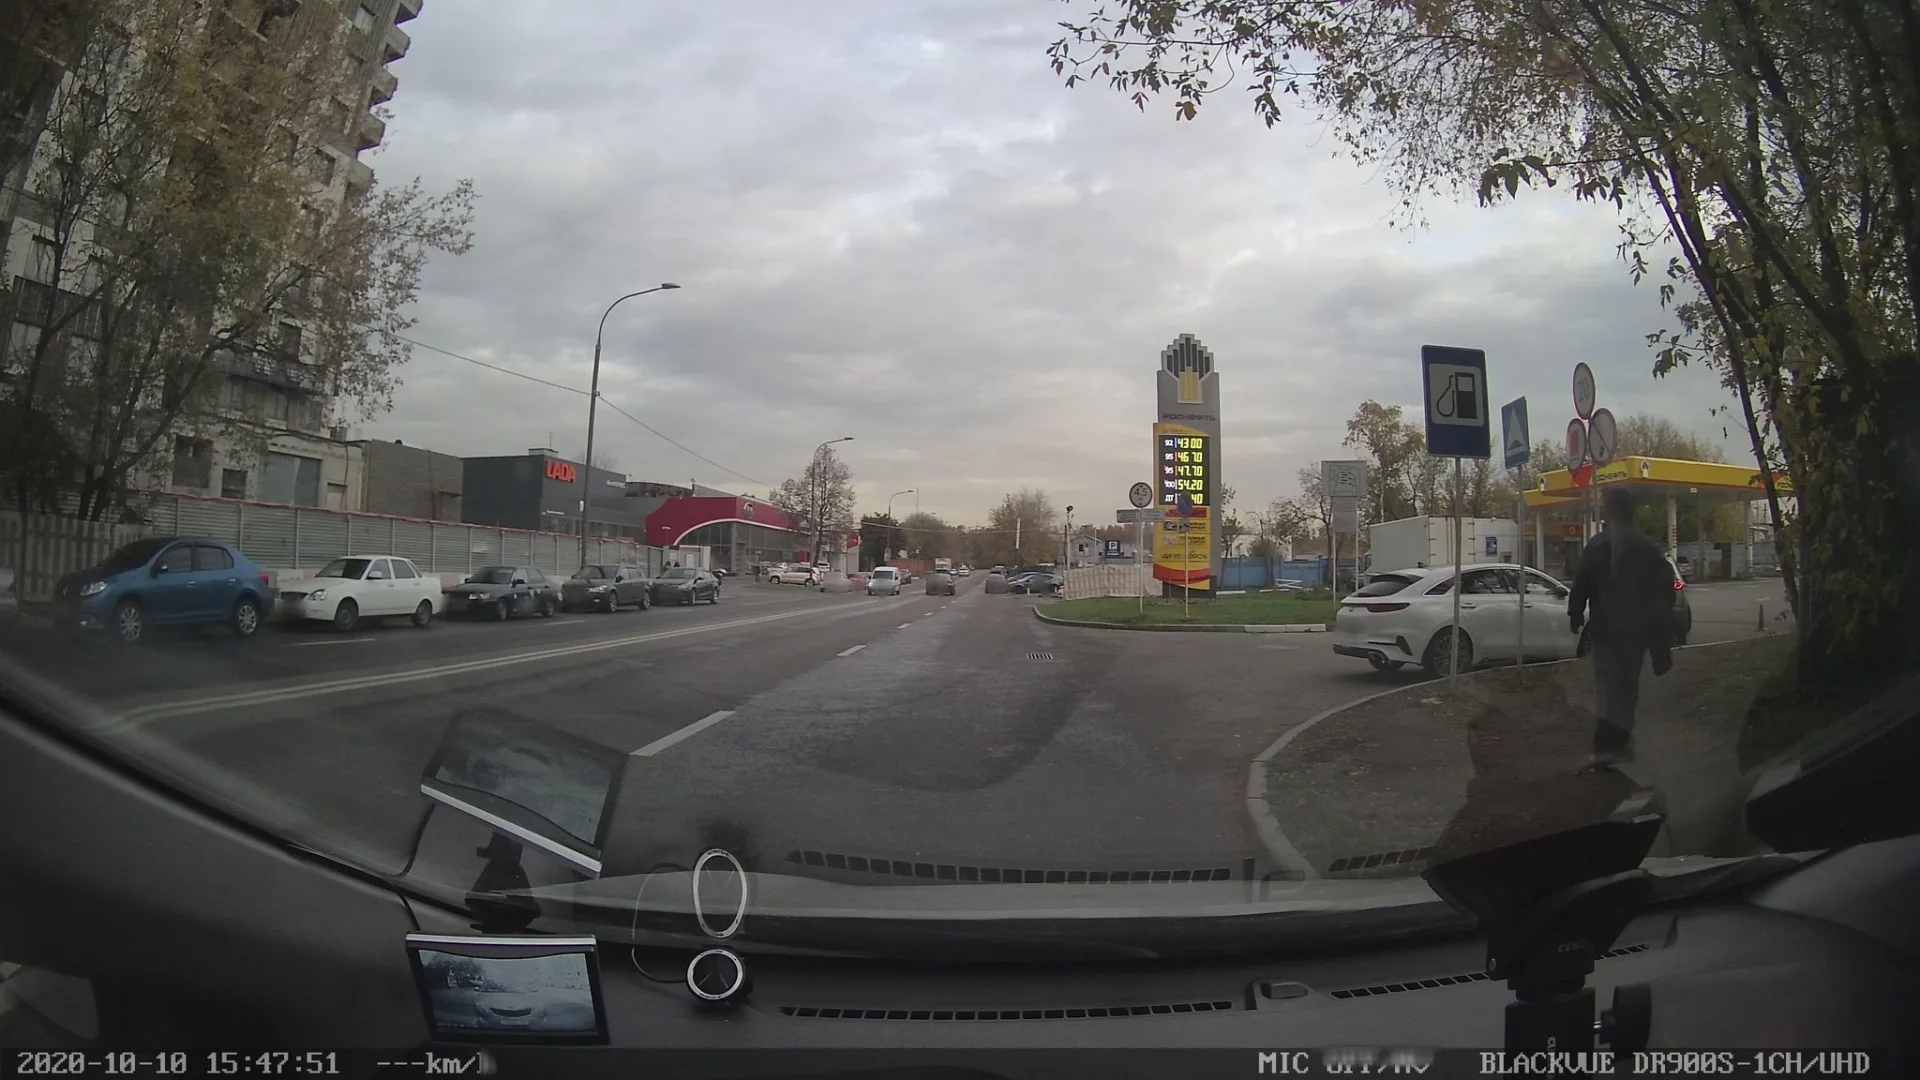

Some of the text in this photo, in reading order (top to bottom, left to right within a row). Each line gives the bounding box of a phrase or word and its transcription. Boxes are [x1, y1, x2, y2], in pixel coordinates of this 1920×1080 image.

[1164, 439, 1174, 447] 92
[546, 459, 577, 483] LADA
[1597, 470, 1628, 482] ОСНЕФТЬ
